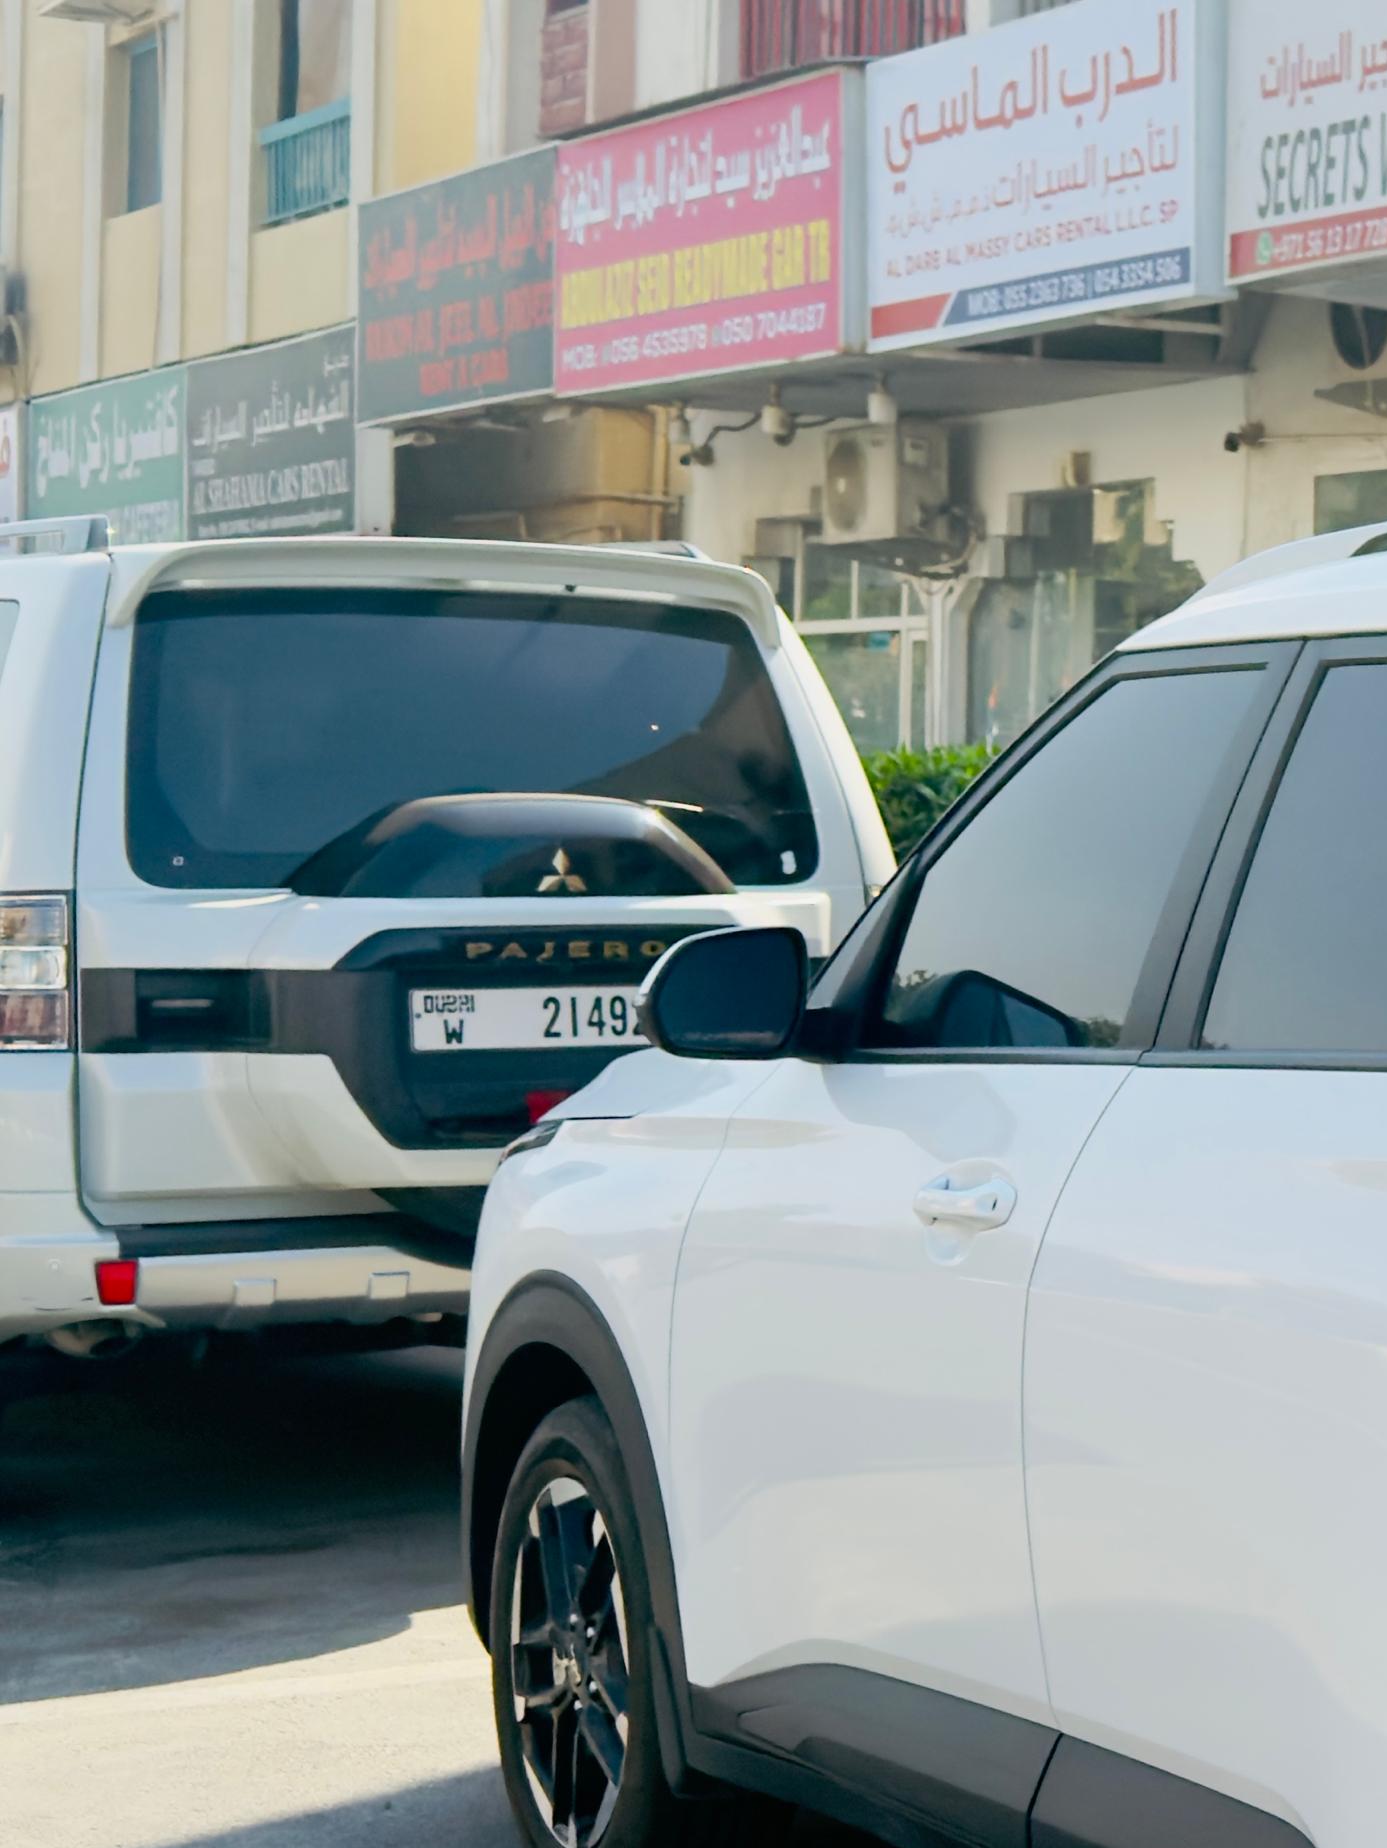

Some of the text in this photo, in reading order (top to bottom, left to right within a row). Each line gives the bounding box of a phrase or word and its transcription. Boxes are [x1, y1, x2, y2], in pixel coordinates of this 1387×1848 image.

[884, 8, 1178, 194] الدرب الماسي
[991, 143, 1097, 216] السيارات
[1103, 120, 1180, 197] لتأجير
[1258, 114, 1371, 219] SECRETS
[1014, 227, 1052, 252] CARS
[1056, 215, 1111, 243] RENTAL
[465, 940, 667, 962] PAJERO
[443, 1019, 464, 1044] W
